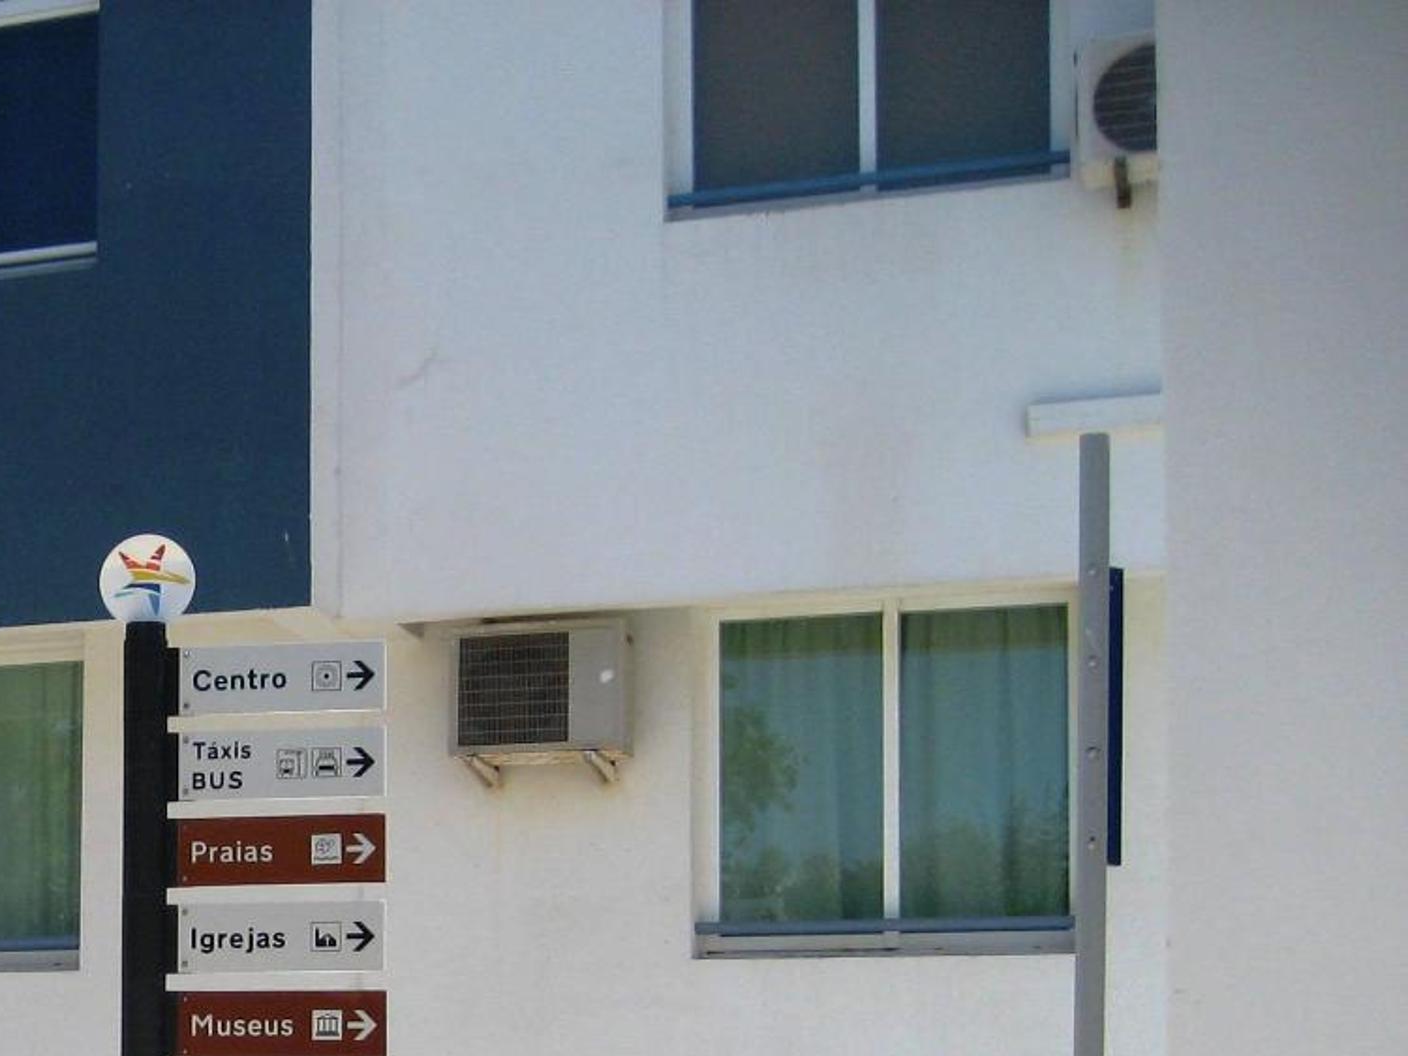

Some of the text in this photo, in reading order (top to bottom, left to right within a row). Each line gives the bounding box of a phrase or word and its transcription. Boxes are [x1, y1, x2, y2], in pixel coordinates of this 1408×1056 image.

[192, 669, 287, 692] Centro
[192, 740, 252, 760] Táxis
[191, 771, 244, 790] BUS
[191, 840, 274, 864] Praias
[191, 927, 286, 954] Igrejas
[191, 1013, 294, 1037] Museus
